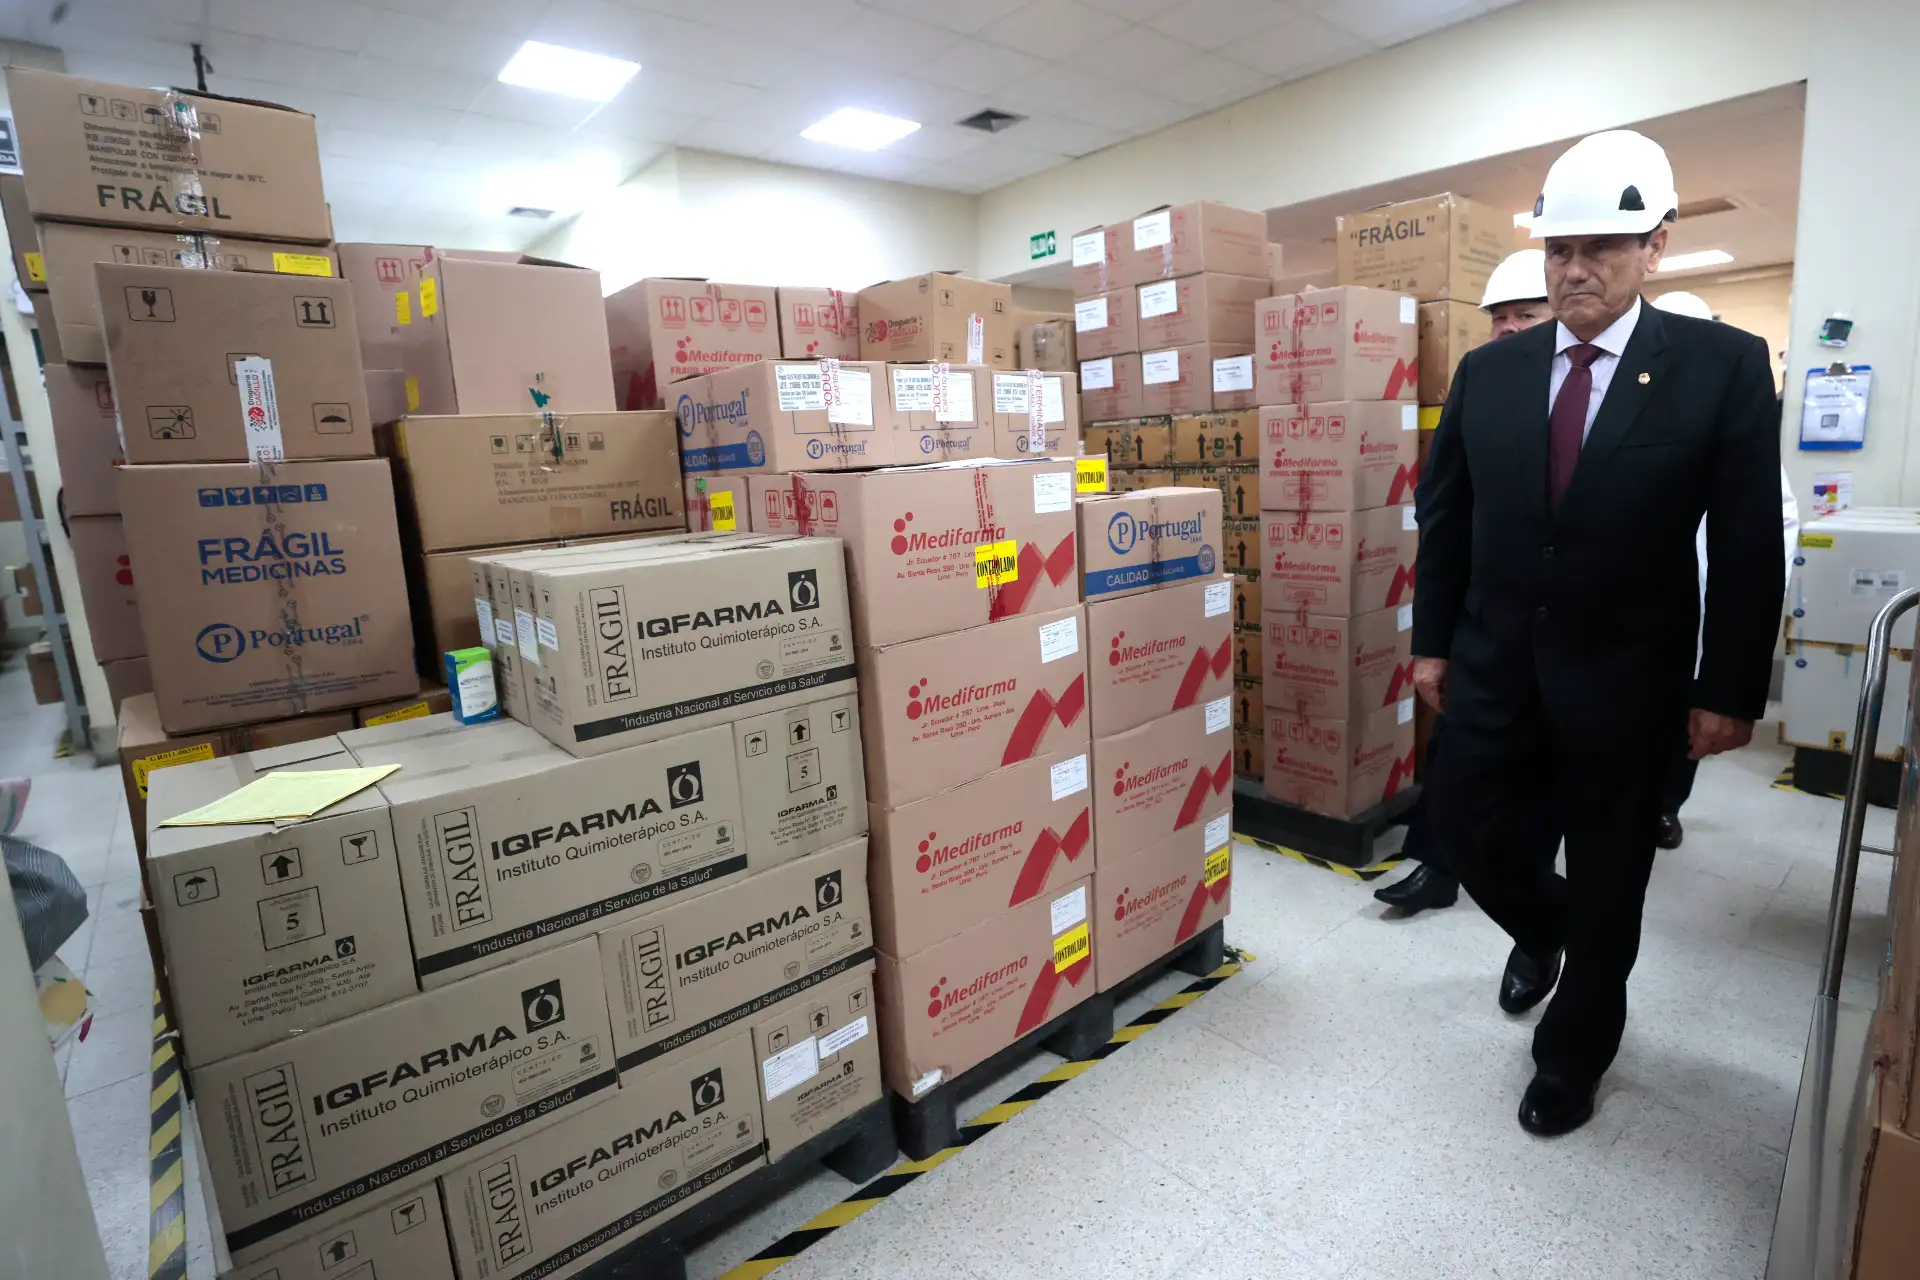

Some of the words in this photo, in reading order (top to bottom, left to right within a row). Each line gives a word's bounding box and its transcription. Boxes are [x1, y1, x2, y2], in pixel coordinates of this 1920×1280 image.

[141, 150, 159, 160] CON
[97, 184, 232, 220] FRÁGIL
[689, 350, 763, 363] Medifarma
[695, 390, 748, 424] Portugal
[1035, 384, 1044, 446] TERMINADO
[825, 440, 866, 456] Portugal
[935, 437, 971, 453] Portugal
[1077, 470, 1105, 484] CONTROLADO
[1282, 459, 1338, 468] Medifarma
[611, 494, 673, 521] FRÁGIL
[909, 526, 1006, 552] Medifarma
[1137, 512, 1202, 541] Portugal
[197, 528, 344, 565] FRÁGIL
[201, 557, 346, 586] MEDICINAS
[977, 555, 1016, 577] CONTROLADO
[1106, 569, 1149, 587] CALIDAD
[1283, 561, 1336, 573] Medifarma
[249, 616, 361, 649] Portugal
[637, 599, 784, 640] IQFARMA
[599, 589, 631, 699] FRAGIL
[641, 639, 696, 661] Instituto
[700, 624, 795, 650] Quimioterápico
[798, 617, 823, 630] S.A.
[1121, 635, 1186, 663] Medifarma
[675, 697, 720, 716] Nacional
[723, 697, 732, 707] al
[734, 686, 773, 703] Servicio
[774, 683, 786, 694] de
[788, 680, 797, 690] la
[924, 678, 1017, 715] Medifarma
[931, 715, 954, 726] Ecuador
[801, 766, 808, 779] 5
[1125, 758, 1188, 791] Medifarma
[777, 798, 825, 818] IQFARMA
[490, 798, 663, 861] IQFARMA
[496, 853, 561, 882] Instituto
[566, 819, 676, 861] Quimioterápico
[679, 810, 708, 826] S.A.
[932, 821, 1023, 867] Medifarma
[440, 811, 485, 926] FRAGIL
[1204, 860, 1227, 882] CONTROLADO
[536, 909, 589, 933] Nacional
[592, 904, 602, 917] al
[605, 890, 650, 912] Servicio
[652, 884, 665, 898] de
[668, 880, 678, 892] la
[1125, 874, 1187, 915] Medifarma
[287, 912, 299, 930] 5
[675, 905, 810, 970] IQFARMA
[679, 960, 729, 987] Instituto
[733, 924, 820, 964] Quimioterápico
[823, 912, 845, 926] S.A.
[1054, 936, 1087, 965] CONTROLADO
[242, 955, 334, 987] IQFARMA
[640, 930, 669, 1028] FRAGIL
[942, 955, 1028, 1010] Medifarma
[252, 1002, 278, 1015] Pedro
[709, 1007, 750, 1031] Nacional
[752, 1001, 761, 1012] al
[763, 984, 798, 1005] Servicio
[800, 977, 811, 989] de
[812, 973, 821, 983] la
[312, 1025, 518, 1116] IQFARMA
[319, 1098, 397, 1138] Instituto
[402, 1044, 532, 1104] Quimioterápico
[536, 1030, 570, 1051] S.A.
[797, 1074, 842, 1101] IQFARMA
[259, 1068, 307, 1193] FRAGIL
[369, 1153, 432, 1188] Nacional
[435, 1143, 448, 1160] al
[450, 1123, 504, 1153] Servicio
[506, 1113, 523, 1130] de
[525, 1106, 537, 1121] la
[531, 1109, 687, 1197] IQFARMA
[534, 1179, 594, 1216] Instituto
[598, 1125, 699, 1182] Quimioterápico
[702, 1110, 729, 1128] S.A.
[487, 1161, 525, 1265] FRAGIL
[572, 1225, 621, 1254] Nacional
[623, 1217, 633, 1231] al
[635, 1194, 677, 1221] Servicio
[678, 1185, 691, 1199] de
[693, 1179, 702, 1192] la
